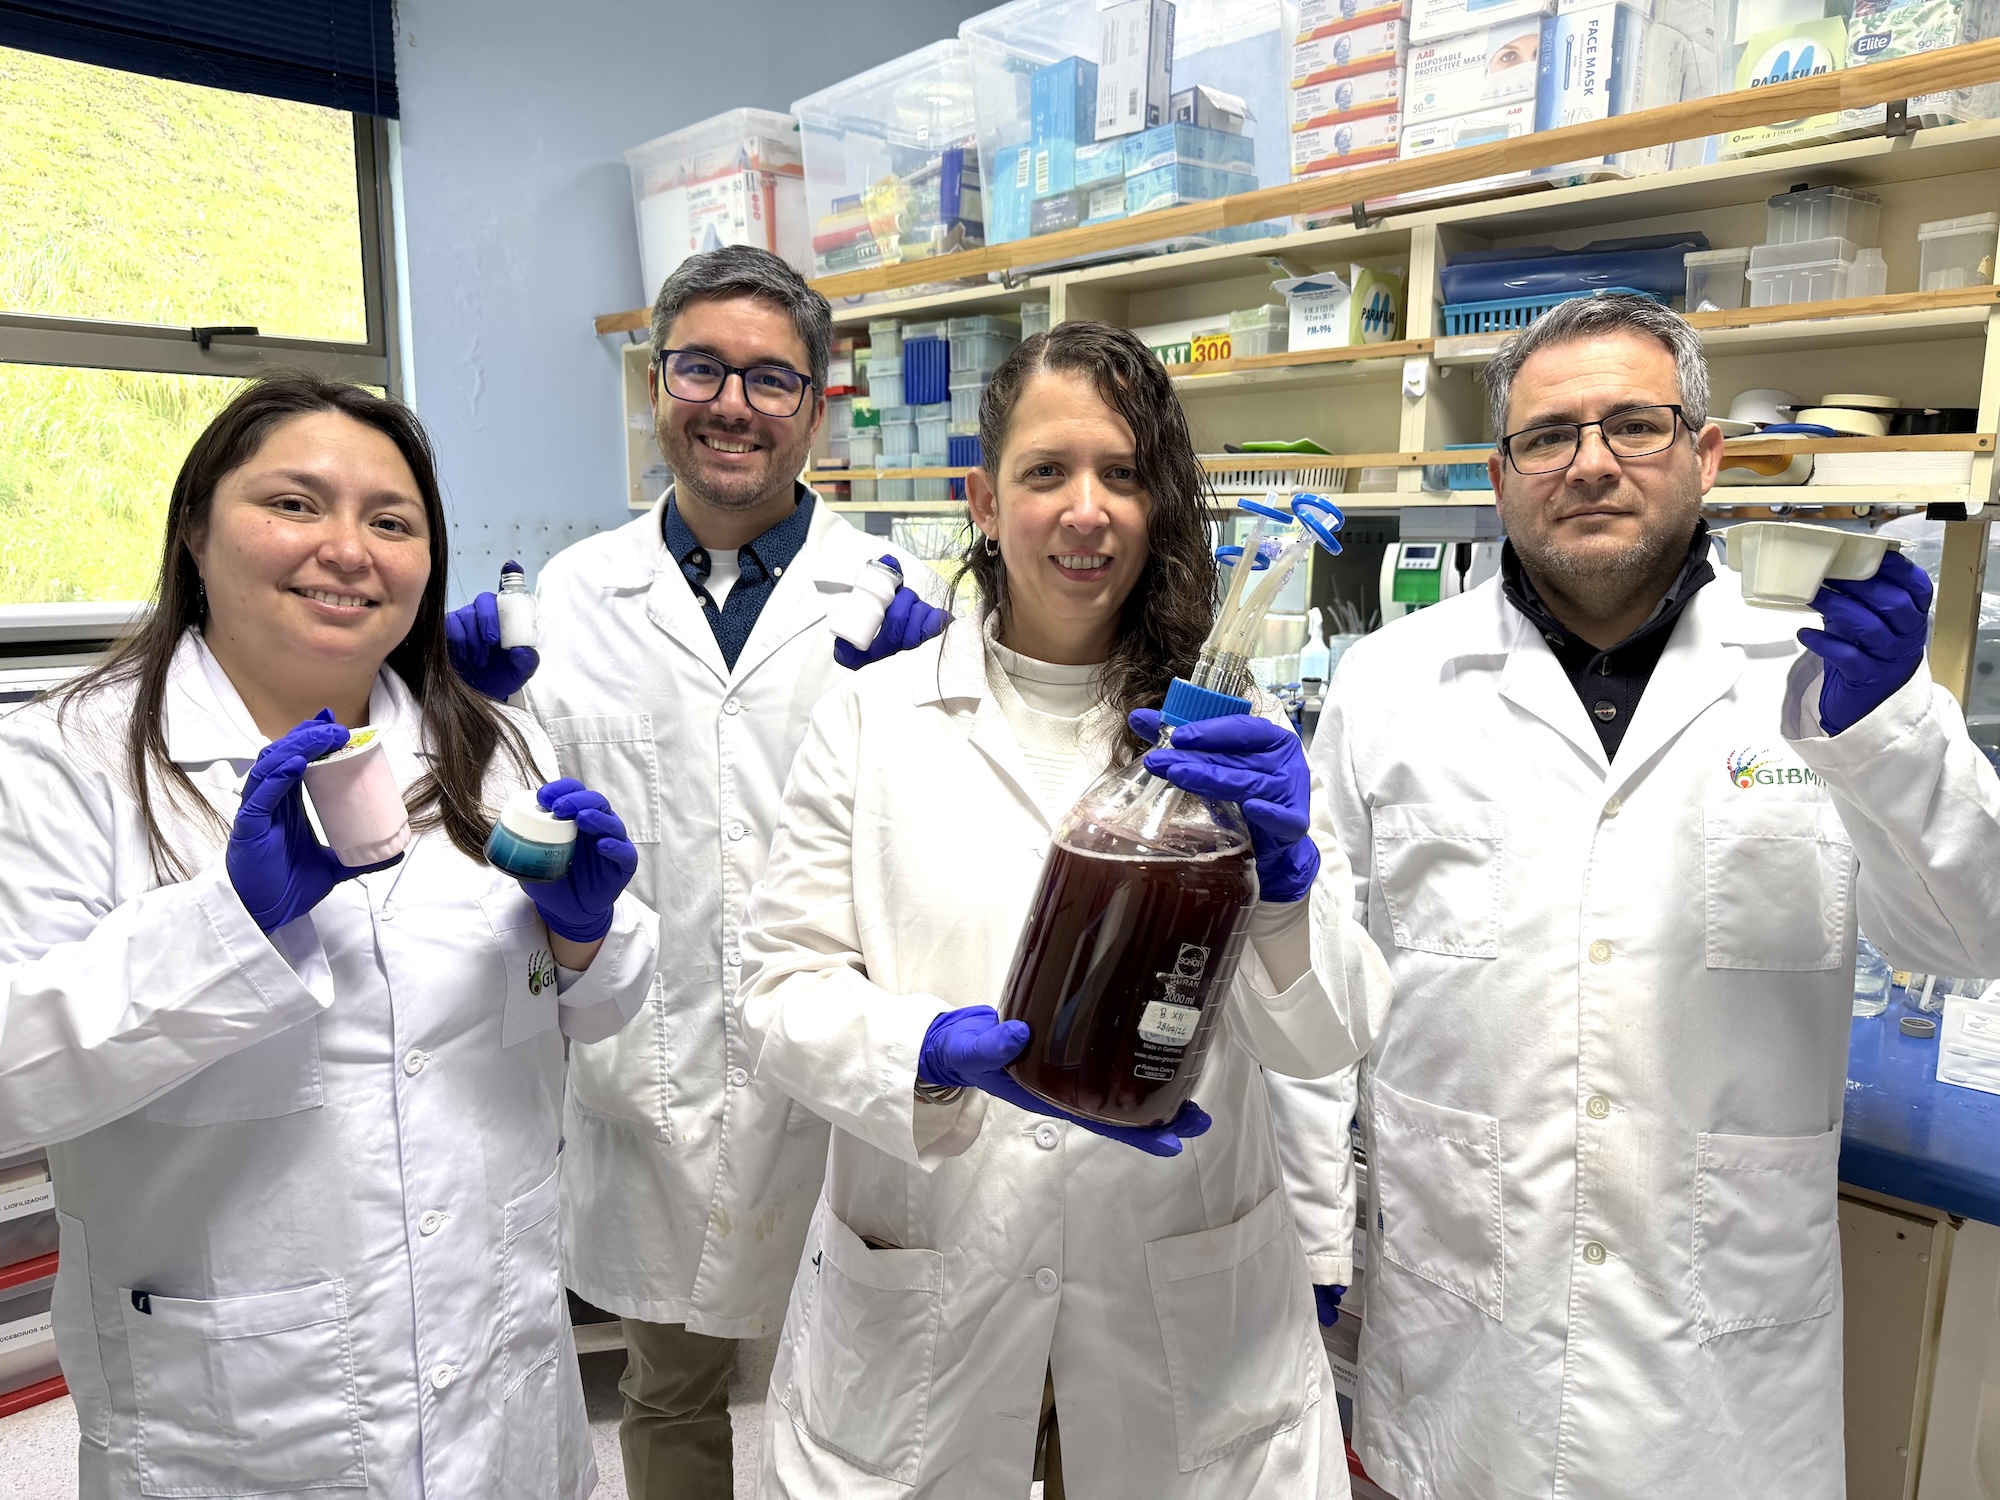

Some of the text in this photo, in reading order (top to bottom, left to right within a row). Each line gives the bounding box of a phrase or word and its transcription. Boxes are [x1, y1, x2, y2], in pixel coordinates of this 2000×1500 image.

[1857, 34, 1889, 53] Elite
[1918, 40, 1932, 49] 90
[1415, 51, 1462, 70] DISPOSABLE
[1416, 49, 1435, 61] AAB
[1583, 19, 1599, 97] FACE MASK
[1414, 61, 1461, 77] PROTECTIVE
[1463, 53, 1487, 66] MASK
[1412, 103, 1424, 114] 50
[1506, 107, 1523, 116] AAB
[1360, 307, 1395, 324] PARAFILM
[1306, 324, 1332, 335] PM-996
[1195, 340, 1231, 363] 300
[1178, 957, 1204, 967] SCHOTT
[542, 966, 557, 988] GI
[1170, 976, 1200, 988] DURAN
[1163, 991, 1186, 1003] 2000
[1142, 1042, 1158, 1051] Made
[4, 1194, 49, 1211] LIOFILIZADOR
[1332, 1371, 1351, 1384] ONDEF
